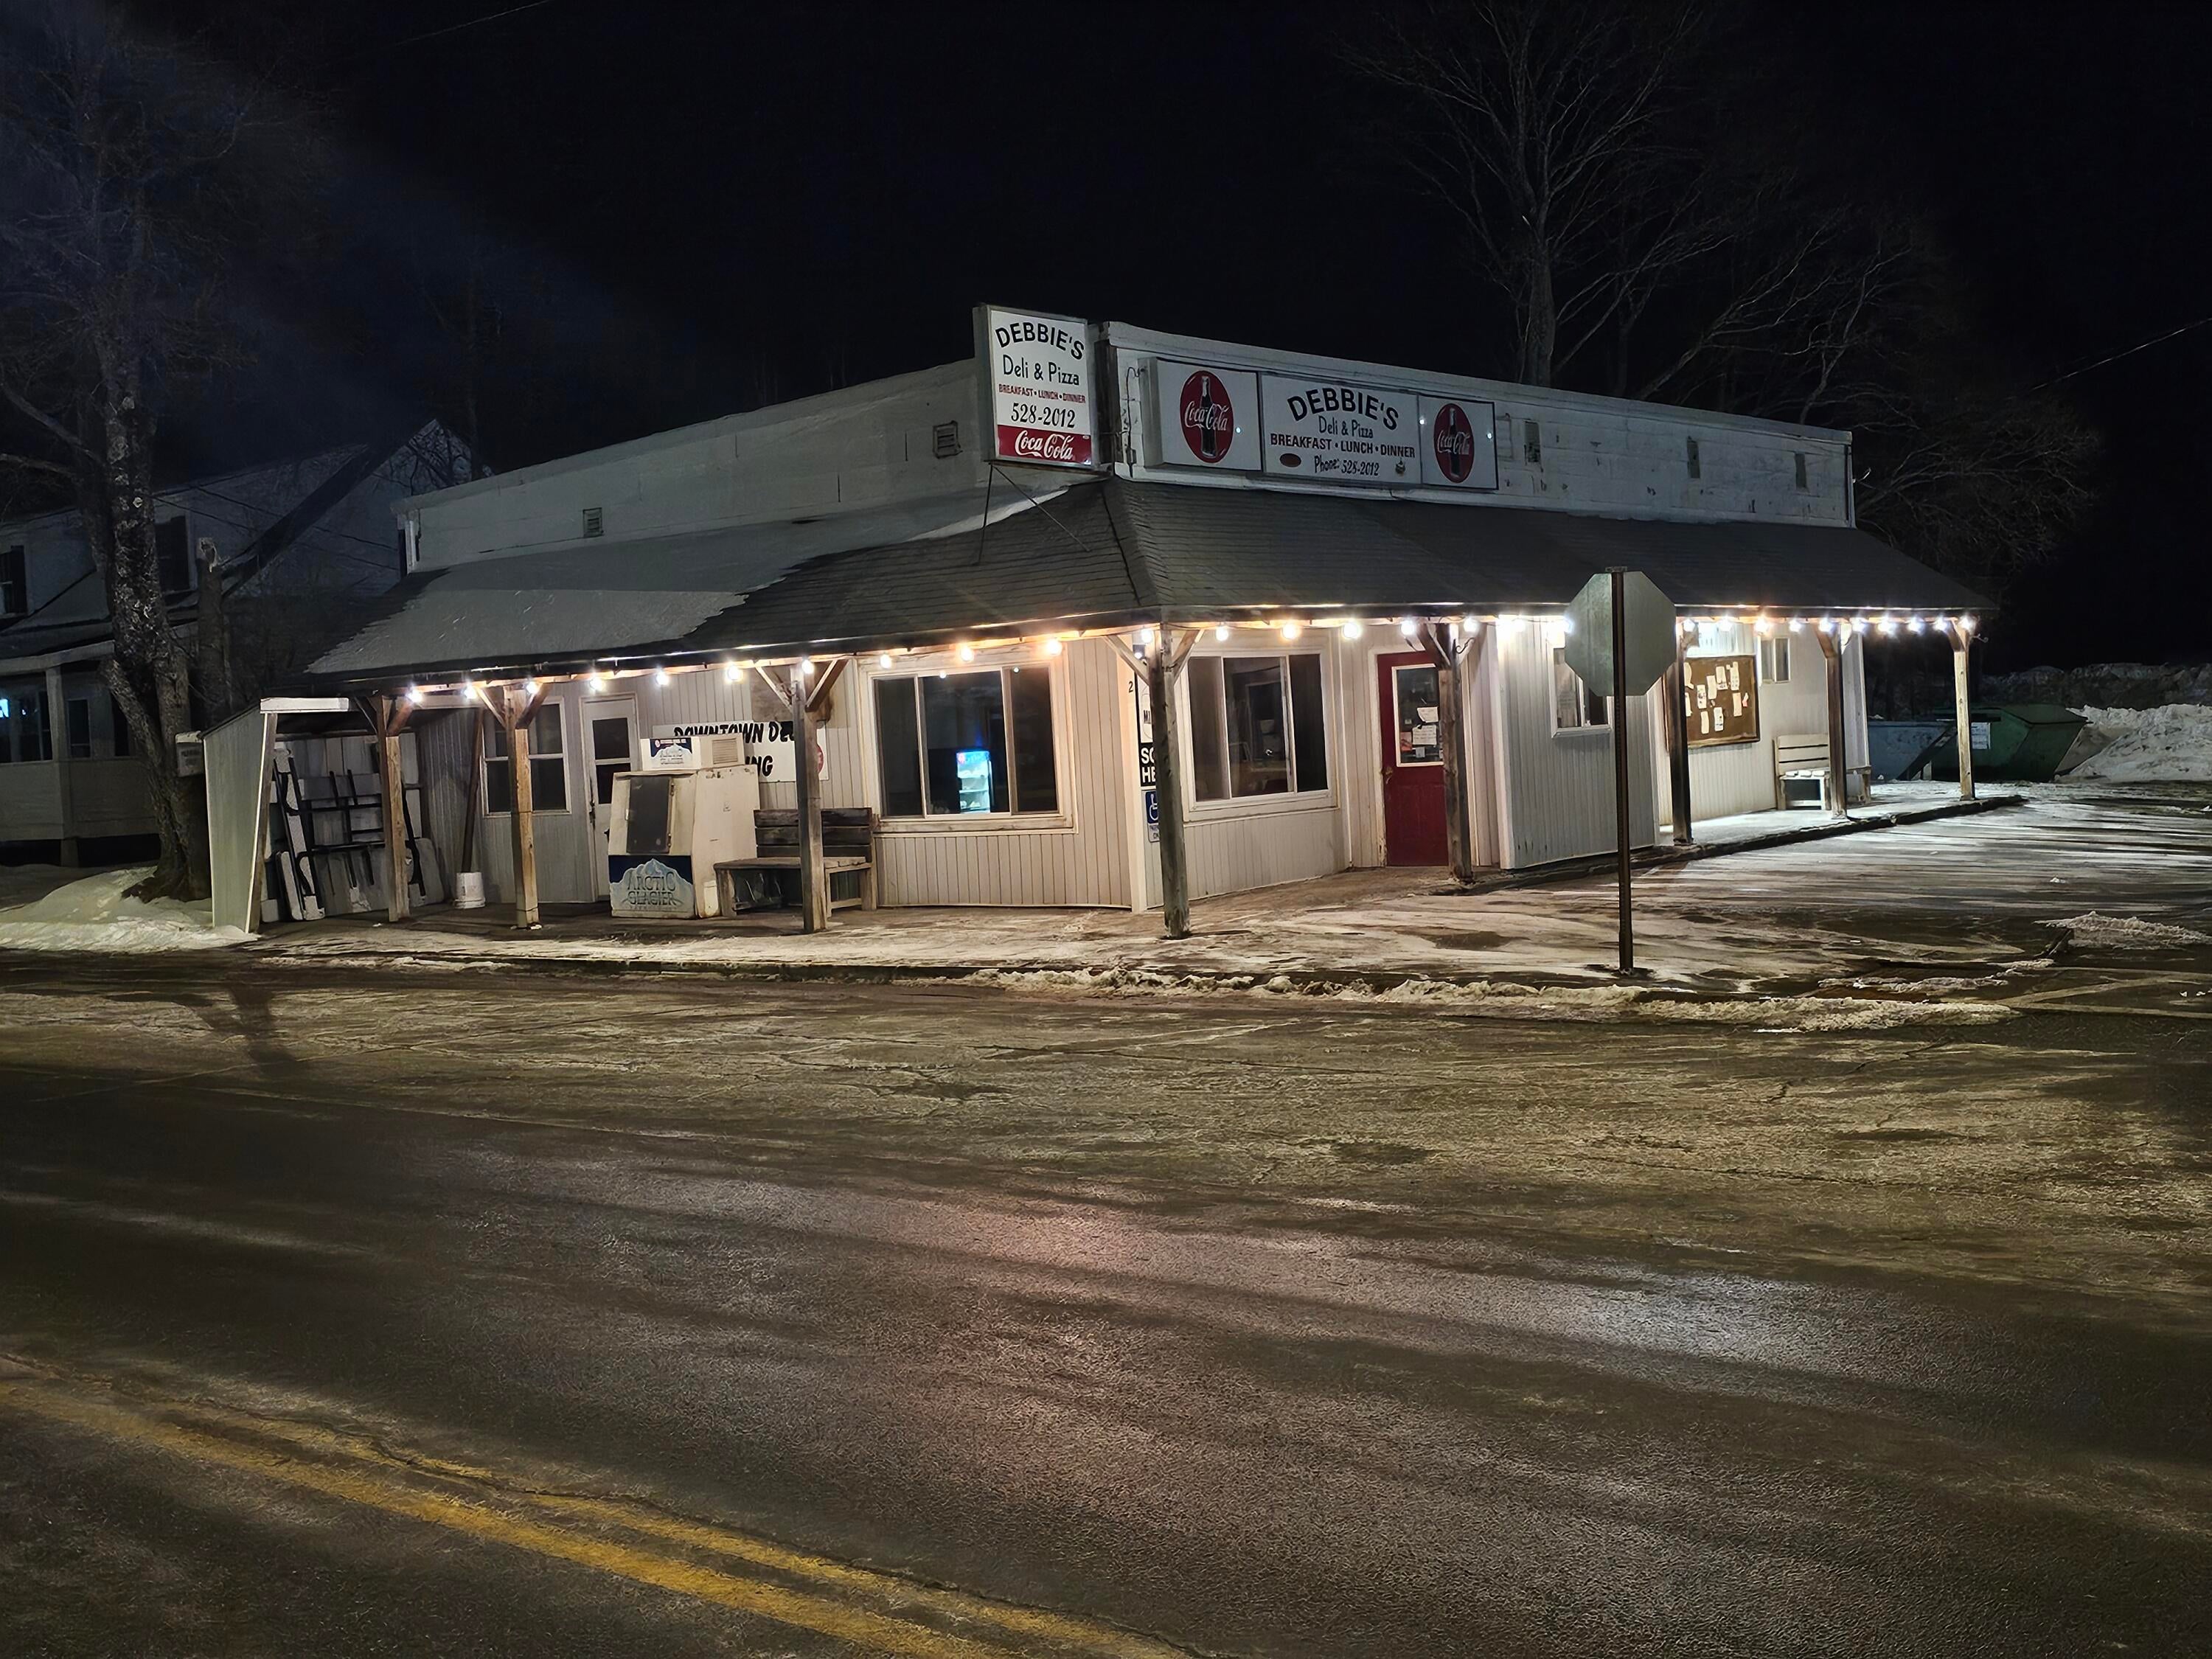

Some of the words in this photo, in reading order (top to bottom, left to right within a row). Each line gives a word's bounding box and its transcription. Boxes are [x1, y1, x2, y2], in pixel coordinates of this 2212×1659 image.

[995, 322, 1084, 360] DEBBIE'S
[1003, 355, 1029, 379] Deli
[1034, 363, 1043, 380] &
[1048, 362, 1079, 386] Pizza
[998, 384, 1033, 397] BREAKFAST
[1038, 390, 1058, 400] LUNCH
[1062, 393, 1086, 403] DINNER
[1011, 403, 1075, 428] 528-2012
[1287, 388, 1399, 430] DEBBIE'S
[1318, 415, 1338, 436] Deli
[1341, 421, 1349, 436] &
[1352, 420, 1374, 439] Pizza
[1270, 433, 1332, 451] BREAKFAST
[1340, 440, 1373, 454] LUNCH
[1380, 444, 1415, 458] DINNER
[1341, 459, 1380, 476] 528-2012
[627, 872, 676, 891] ARCTIC
